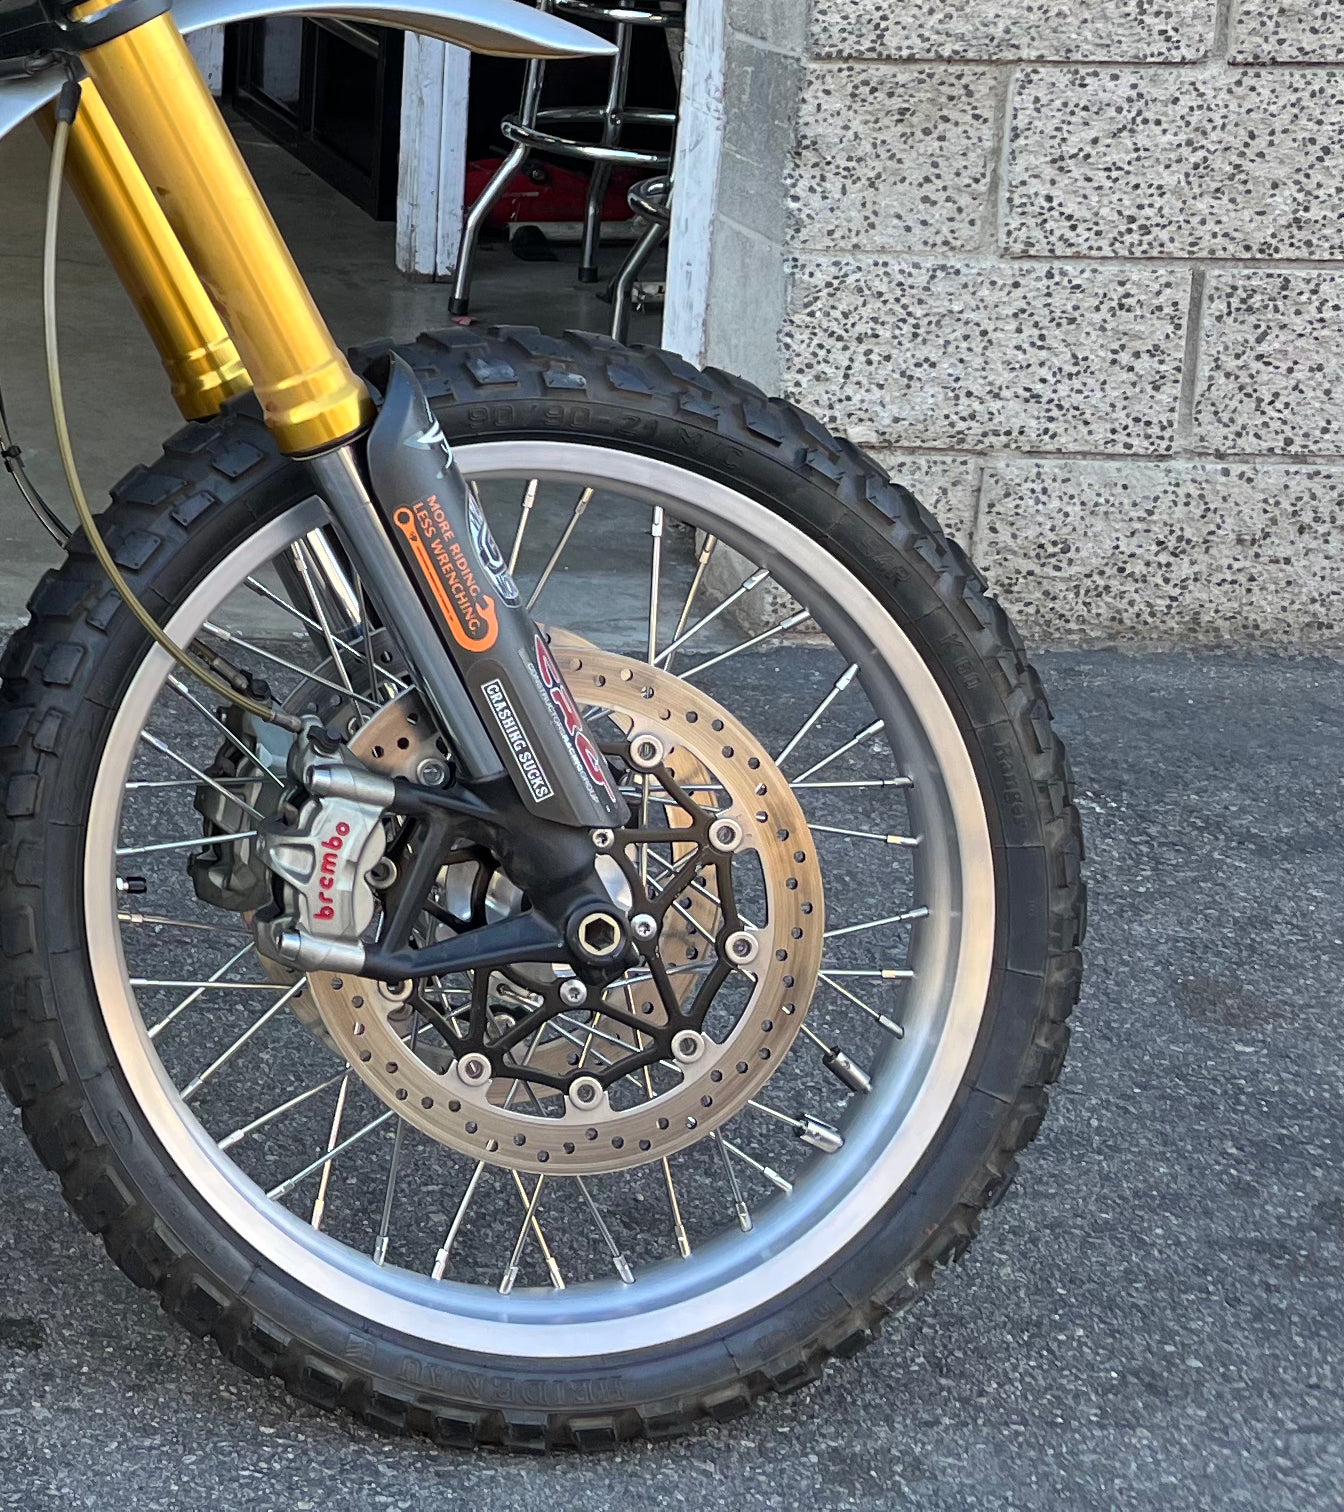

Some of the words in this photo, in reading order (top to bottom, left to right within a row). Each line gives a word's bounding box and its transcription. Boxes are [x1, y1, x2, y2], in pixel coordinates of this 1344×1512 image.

[413, 502, 433, 539] LESS
[427, 494, 454, 543] MORE
[487, 684, 526, 751] CRASHING
[518, 751, 549, 797] SUCKS
[313, 821, 351, 920] brembo
